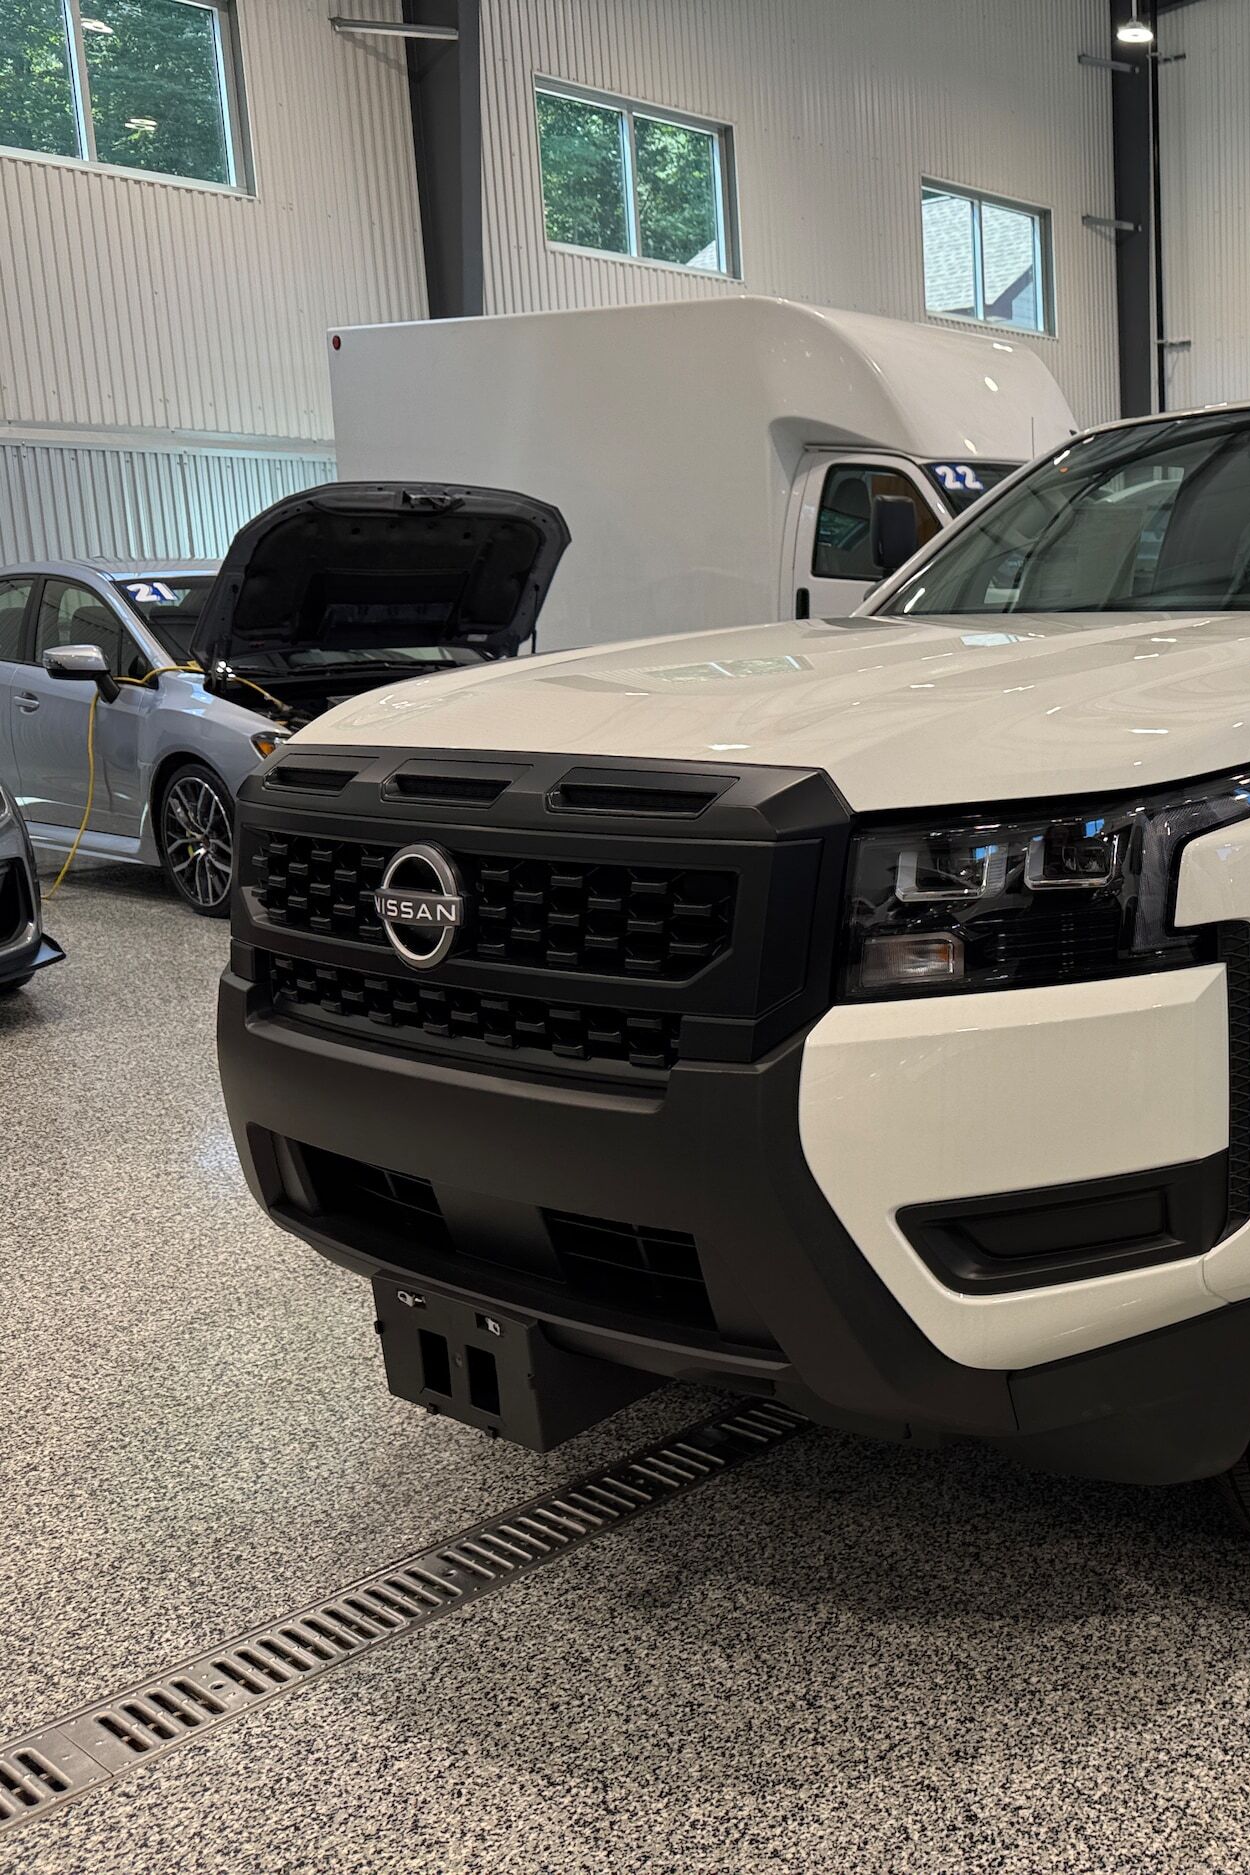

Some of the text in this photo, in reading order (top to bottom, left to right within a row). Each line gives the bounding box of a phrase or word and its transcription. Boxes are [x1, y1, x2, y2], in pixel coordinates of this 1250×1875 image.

[935, 465, 983, 490] 22
[126, 582, 178, 602] 21
[375, 896, 456, 921] NISSAN
